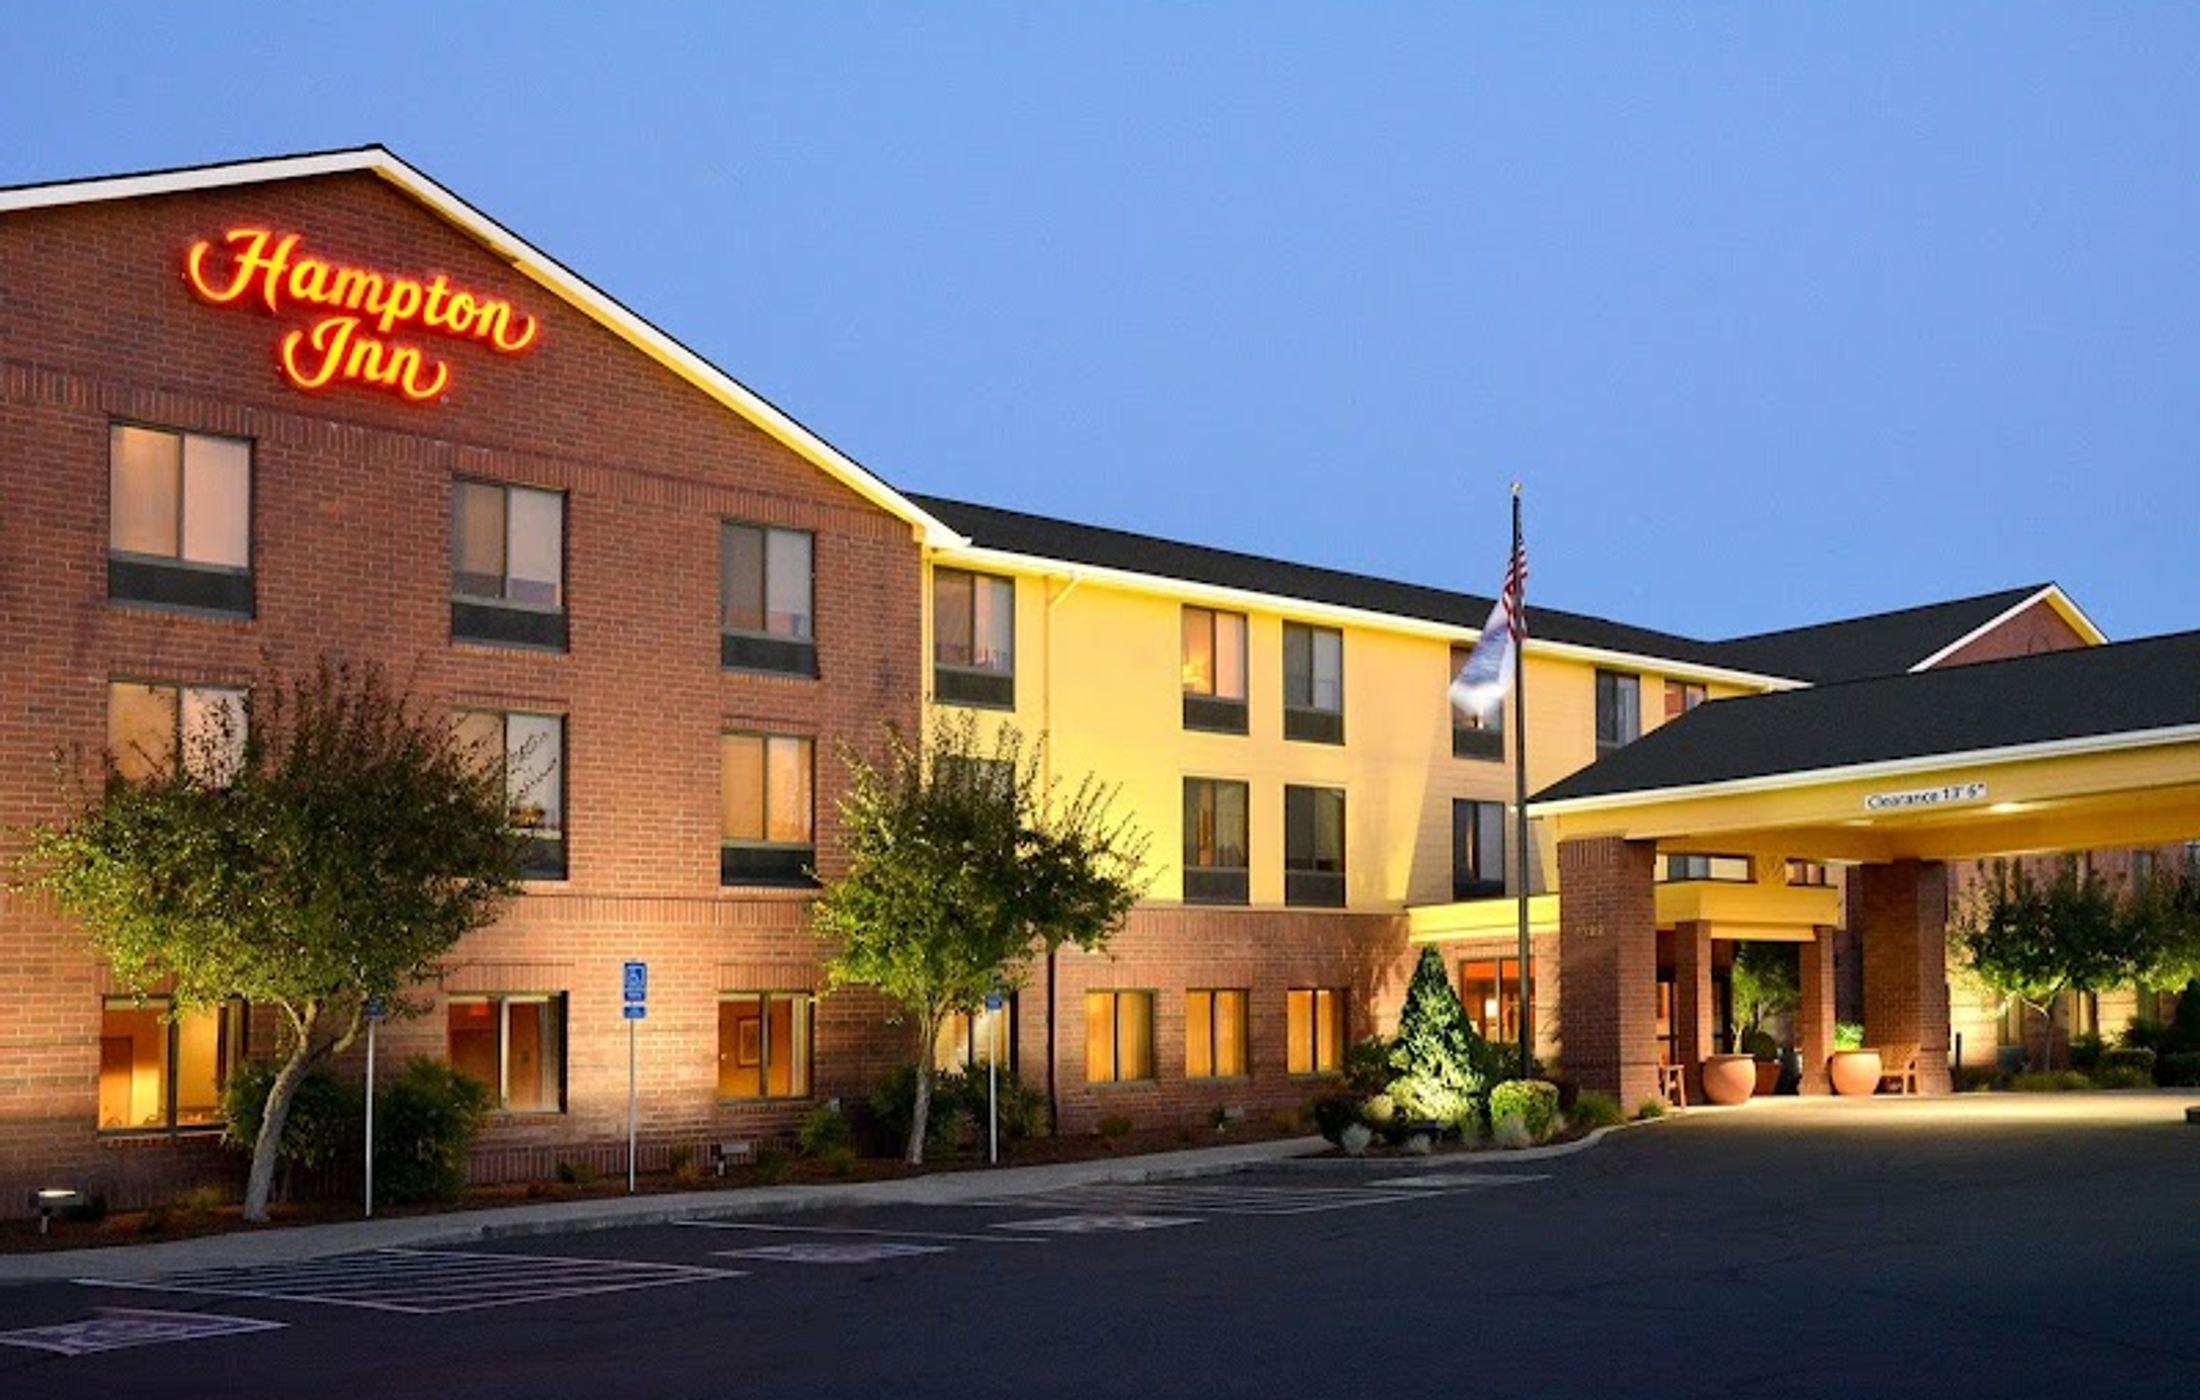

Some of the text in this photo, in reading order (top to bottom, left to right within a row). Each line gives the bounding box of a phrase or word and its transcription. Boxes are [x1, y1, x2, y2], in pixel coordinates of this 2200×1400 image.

[188, 227, 537, 351] Hampton
[283, 316, 448, 399] Inn
[1867, 791, 1938, 809] Clearance
